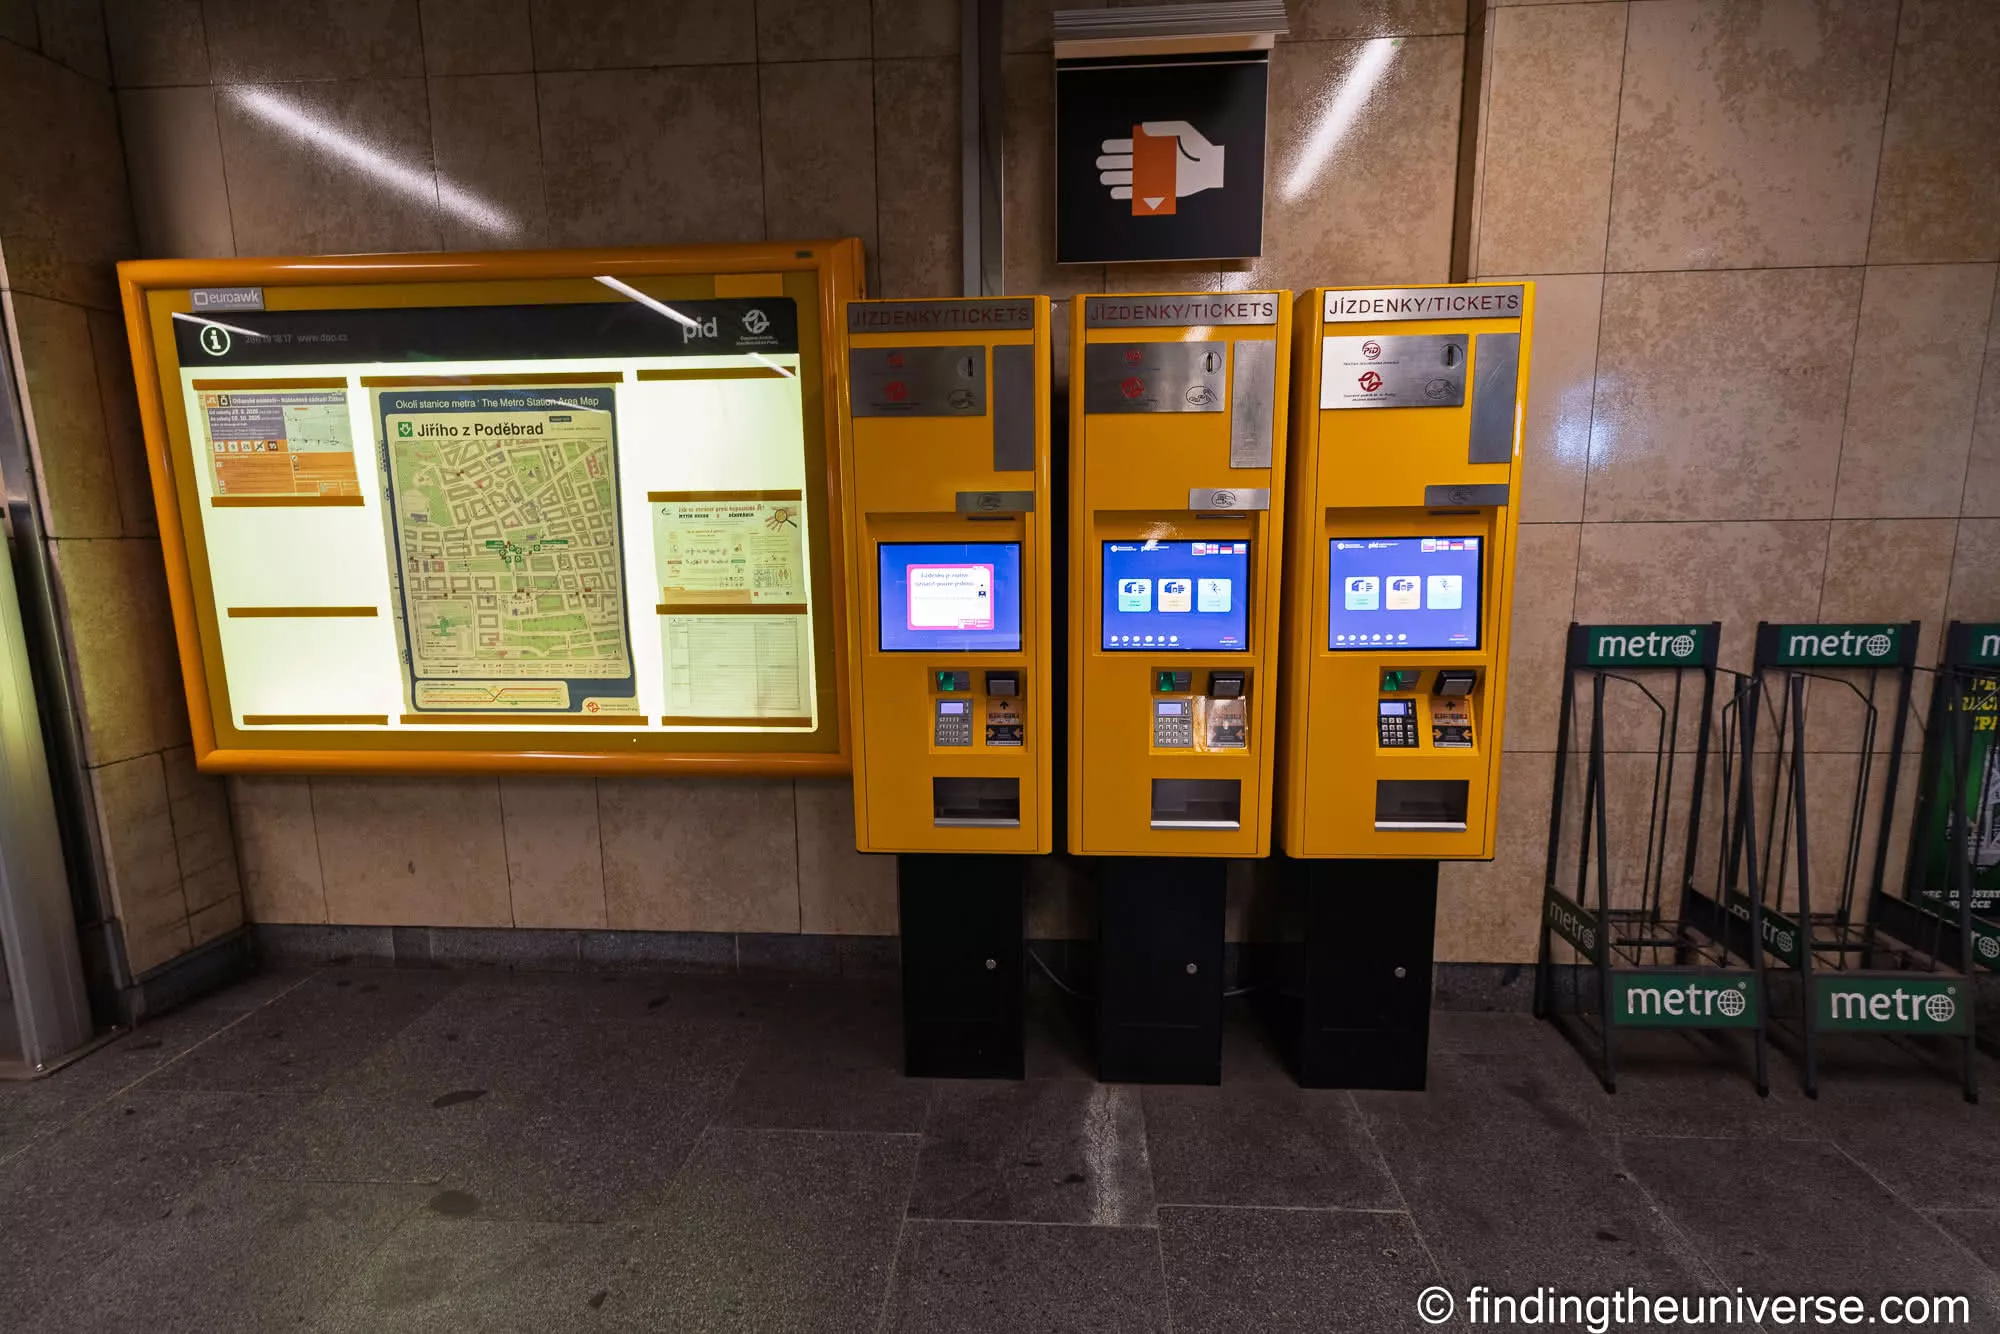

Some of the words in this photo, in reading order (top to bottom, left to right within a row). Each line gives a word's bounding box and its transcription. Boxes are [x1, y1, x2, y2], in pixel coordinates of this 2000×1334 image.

[209, 290, 258, 304] euroawk
[1329, 294, 1519, 315] JÍZDENKY/TICKETS
[853, 307, 1029, 327] JÍZDENKY/TICKETS
[1090, 302, 1273, 321] JÍZDENKY/TICKETS
[682, 316, 718, 344] pid
[419, 399, 449, 409] stanice
[451, 399, 476, 408] metra
[482, 398, 498, 408] The
[500, 398, 525, 408] Metro
[580, 396, 599, 407] Map
[417, 423, 458, 438] Jiřího
[462, 426, 471, 436] z
[474, 421, 544, 437] Poděbrad
[1598, 631, 1694, 657] metro
[1789, 630, 1891, 657] metro
[1550, 901, 1595, 950] metro
[1627, 983, 1746, 1017] metro
[1831, 988, 1955, 1022] metro
